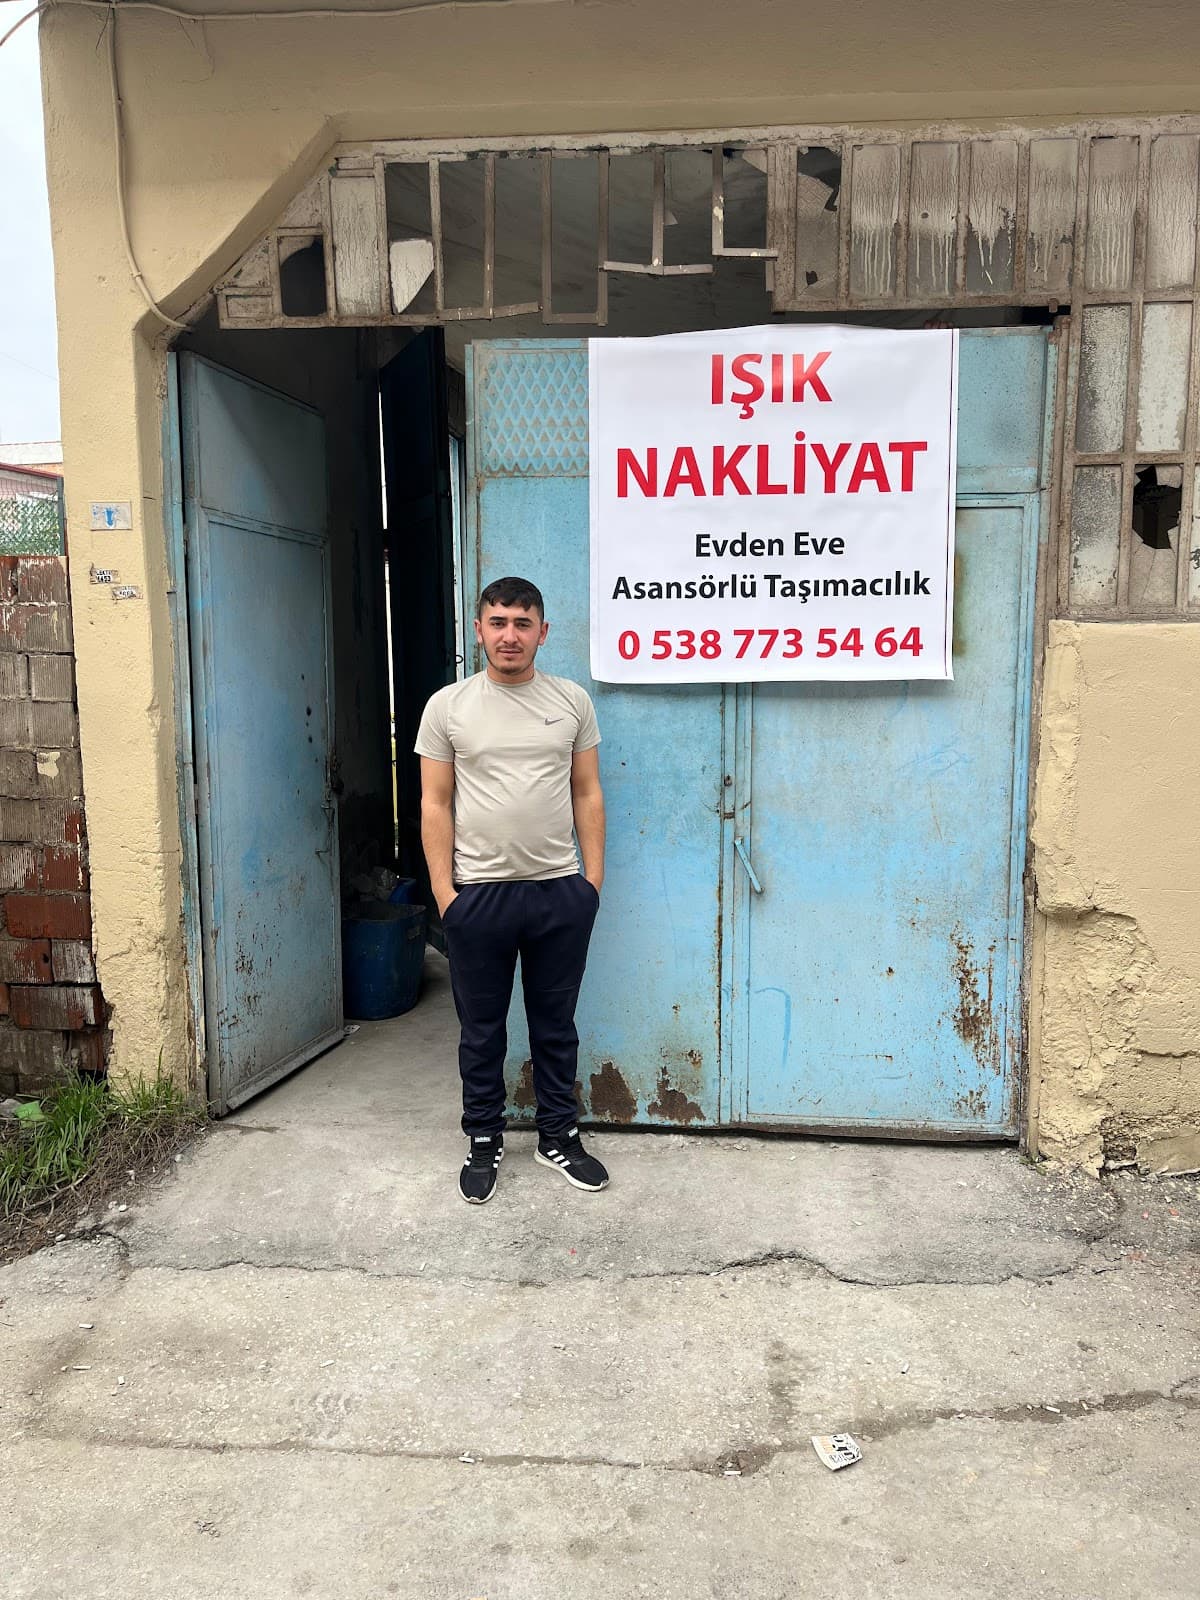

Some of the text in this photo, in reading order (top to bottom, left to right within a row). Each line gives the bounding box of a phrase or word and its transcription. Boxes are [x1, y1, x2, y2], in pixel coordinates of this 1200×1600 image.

[711, 351, 833, 420] IŞIK
[616, 430, 928, 498] NAKLİYAT
[695, 532, 845, 558] Evden Eve
[612, 570, 931, 604] Asansörlü Taşımacılık
[618, 626, 924, 661] 0 538 773 54 64
